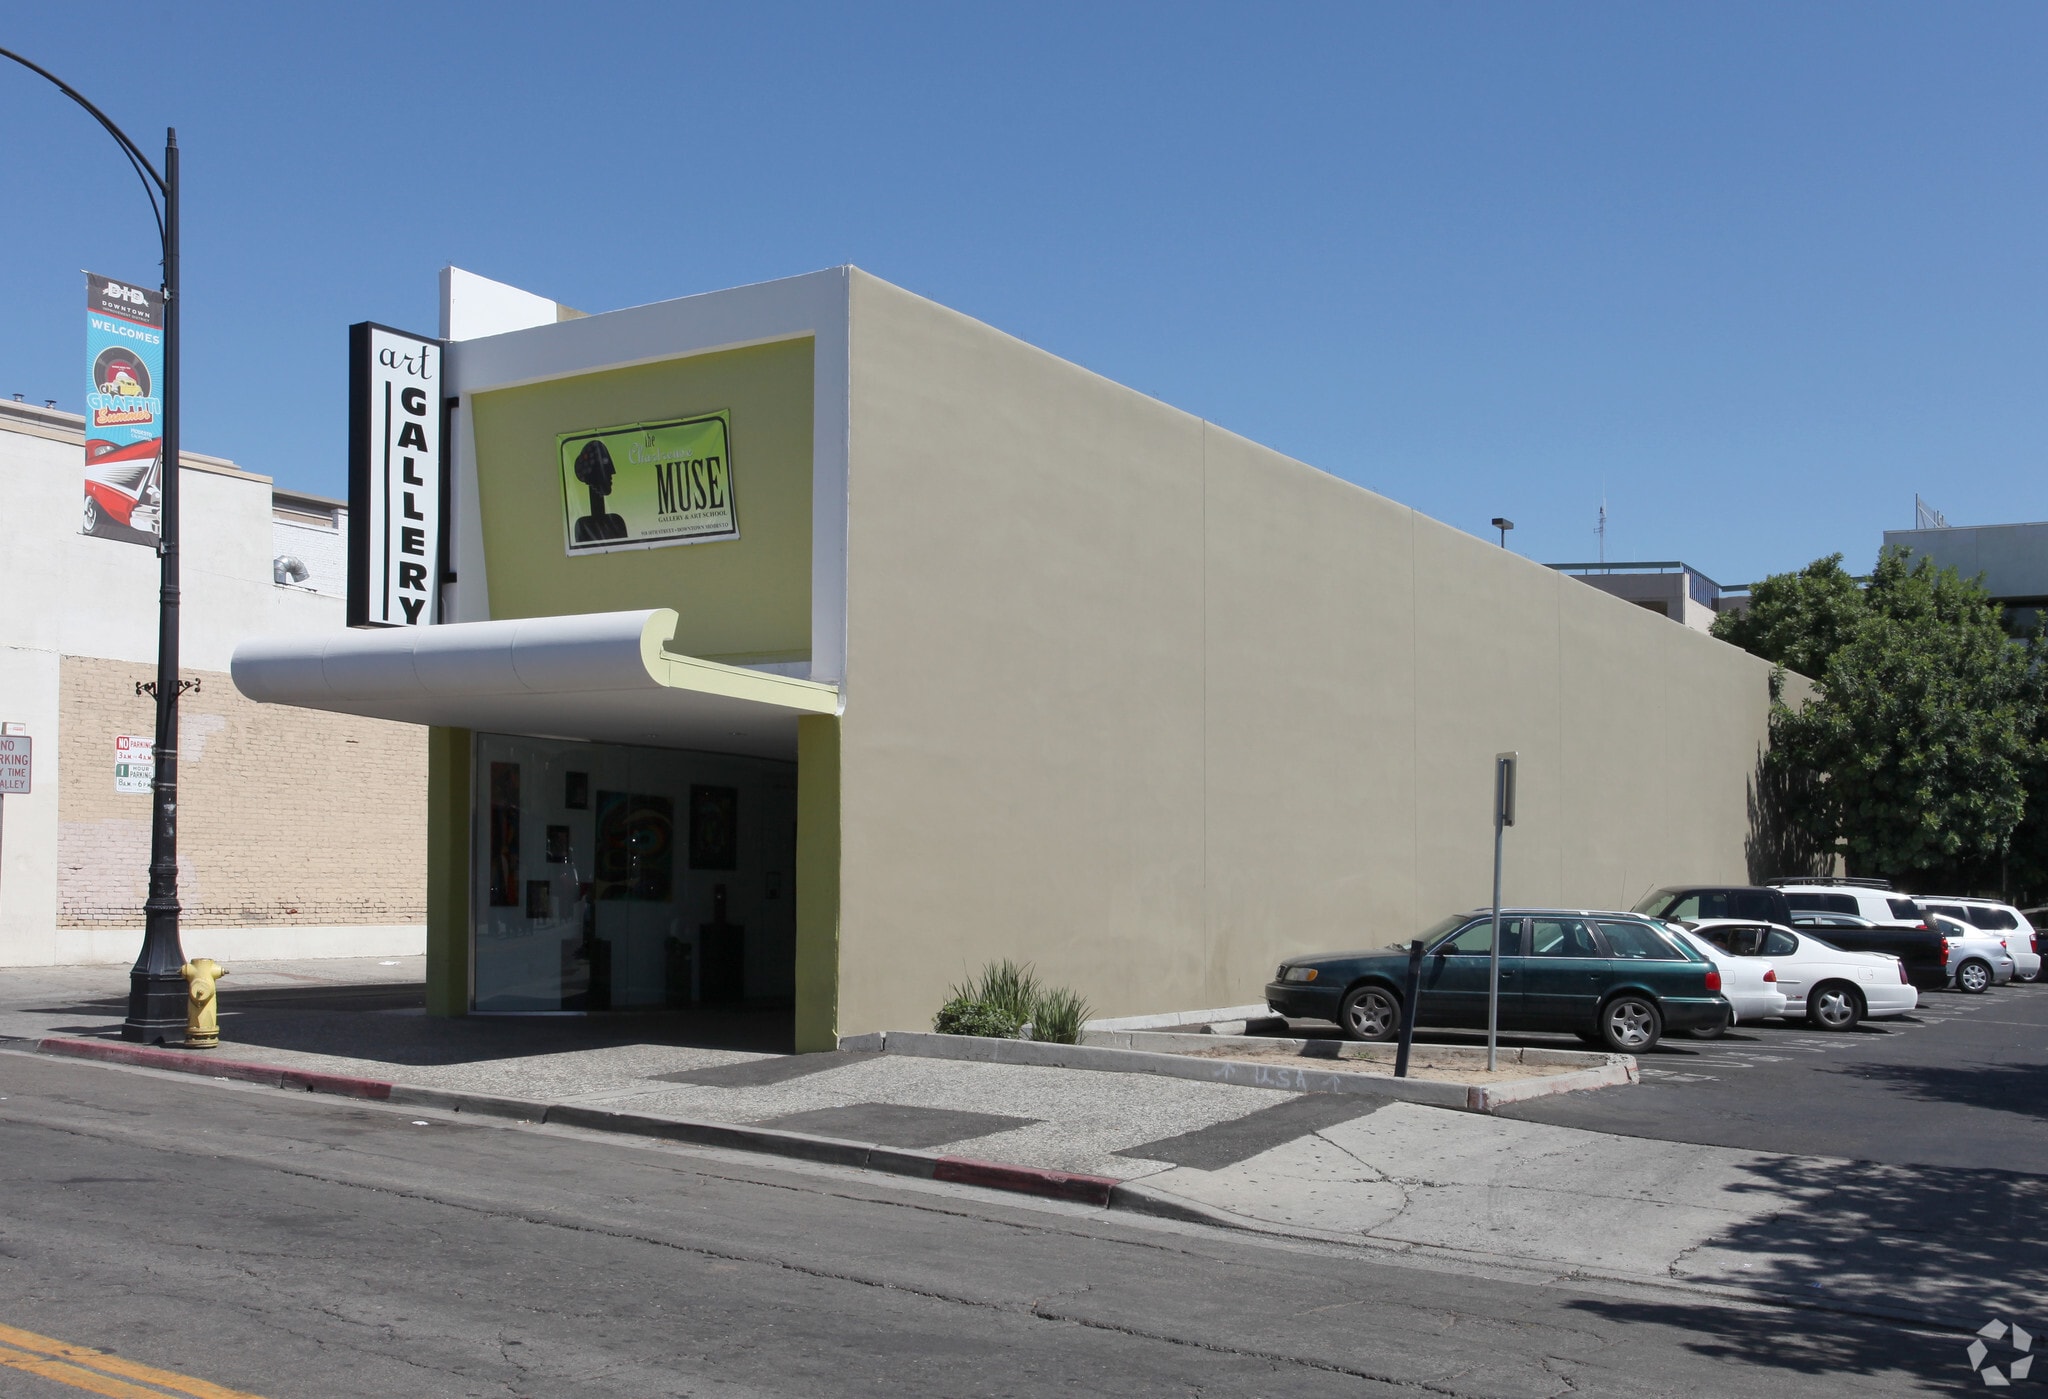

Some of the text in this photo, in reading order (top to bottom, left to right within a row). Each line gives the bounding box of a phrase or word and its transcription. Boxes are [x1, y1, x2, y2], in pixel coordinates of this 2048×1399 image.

[102, 300, 150, 318] DOWNTOWN
[91, 318, 160, 345] WELCOMES
[379, 345, 432, 380] art
[86, 392, 161, 415] GRAFFITI
[96, 407, 151, 424] Summer
[655, 456, 725, 515] MUSE
[397, 386, 429, 626] GALLERY
[658, 514, 683, 523] GALLERY
[690, 511, 702, 520] ART
[702, 510, 727, 518] SCHOOL
[0, 740, 15, 751] NO
[118, 738, 129, 750] NO
[8, 767, 26, 777] TIME
[120, 765, 125, 776] 1
[130, 771, 152, 779] PARKING
